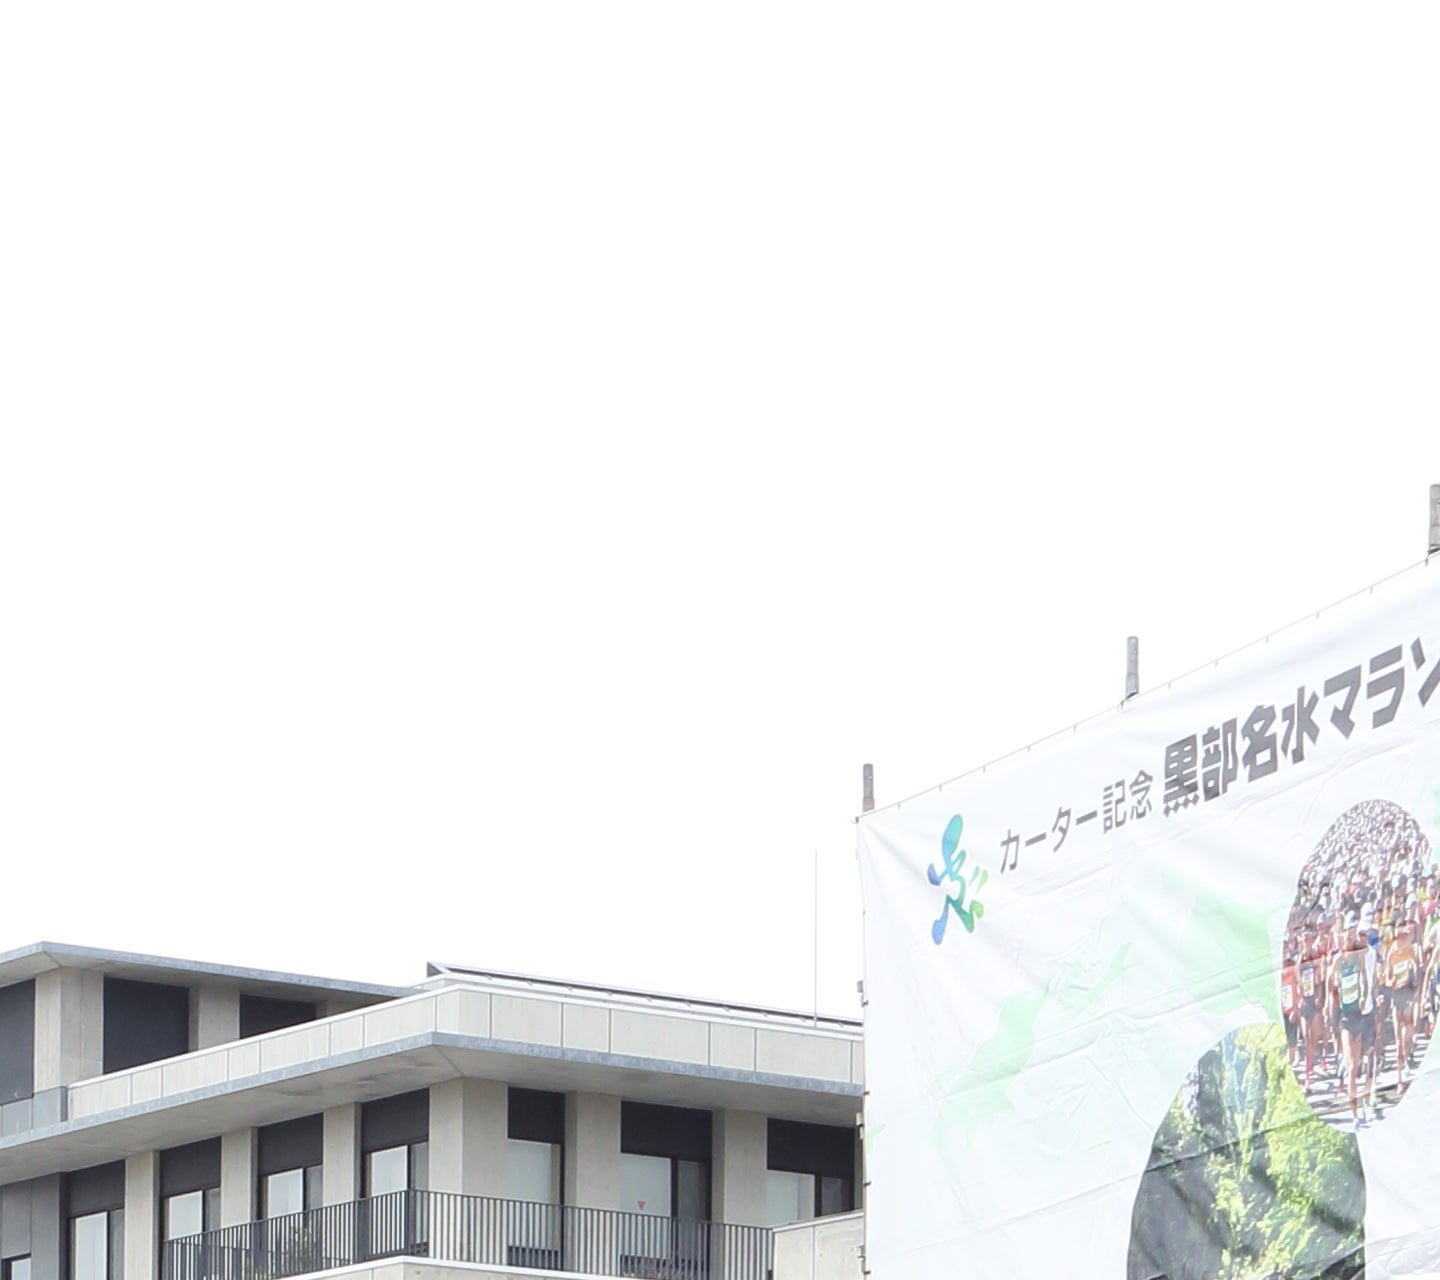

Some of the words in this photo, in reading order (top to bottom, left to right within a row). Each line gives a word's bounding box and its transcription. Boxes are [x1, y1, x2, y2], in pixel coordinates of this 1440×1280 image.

[1000, 770, 1154, 875] カーター記念
